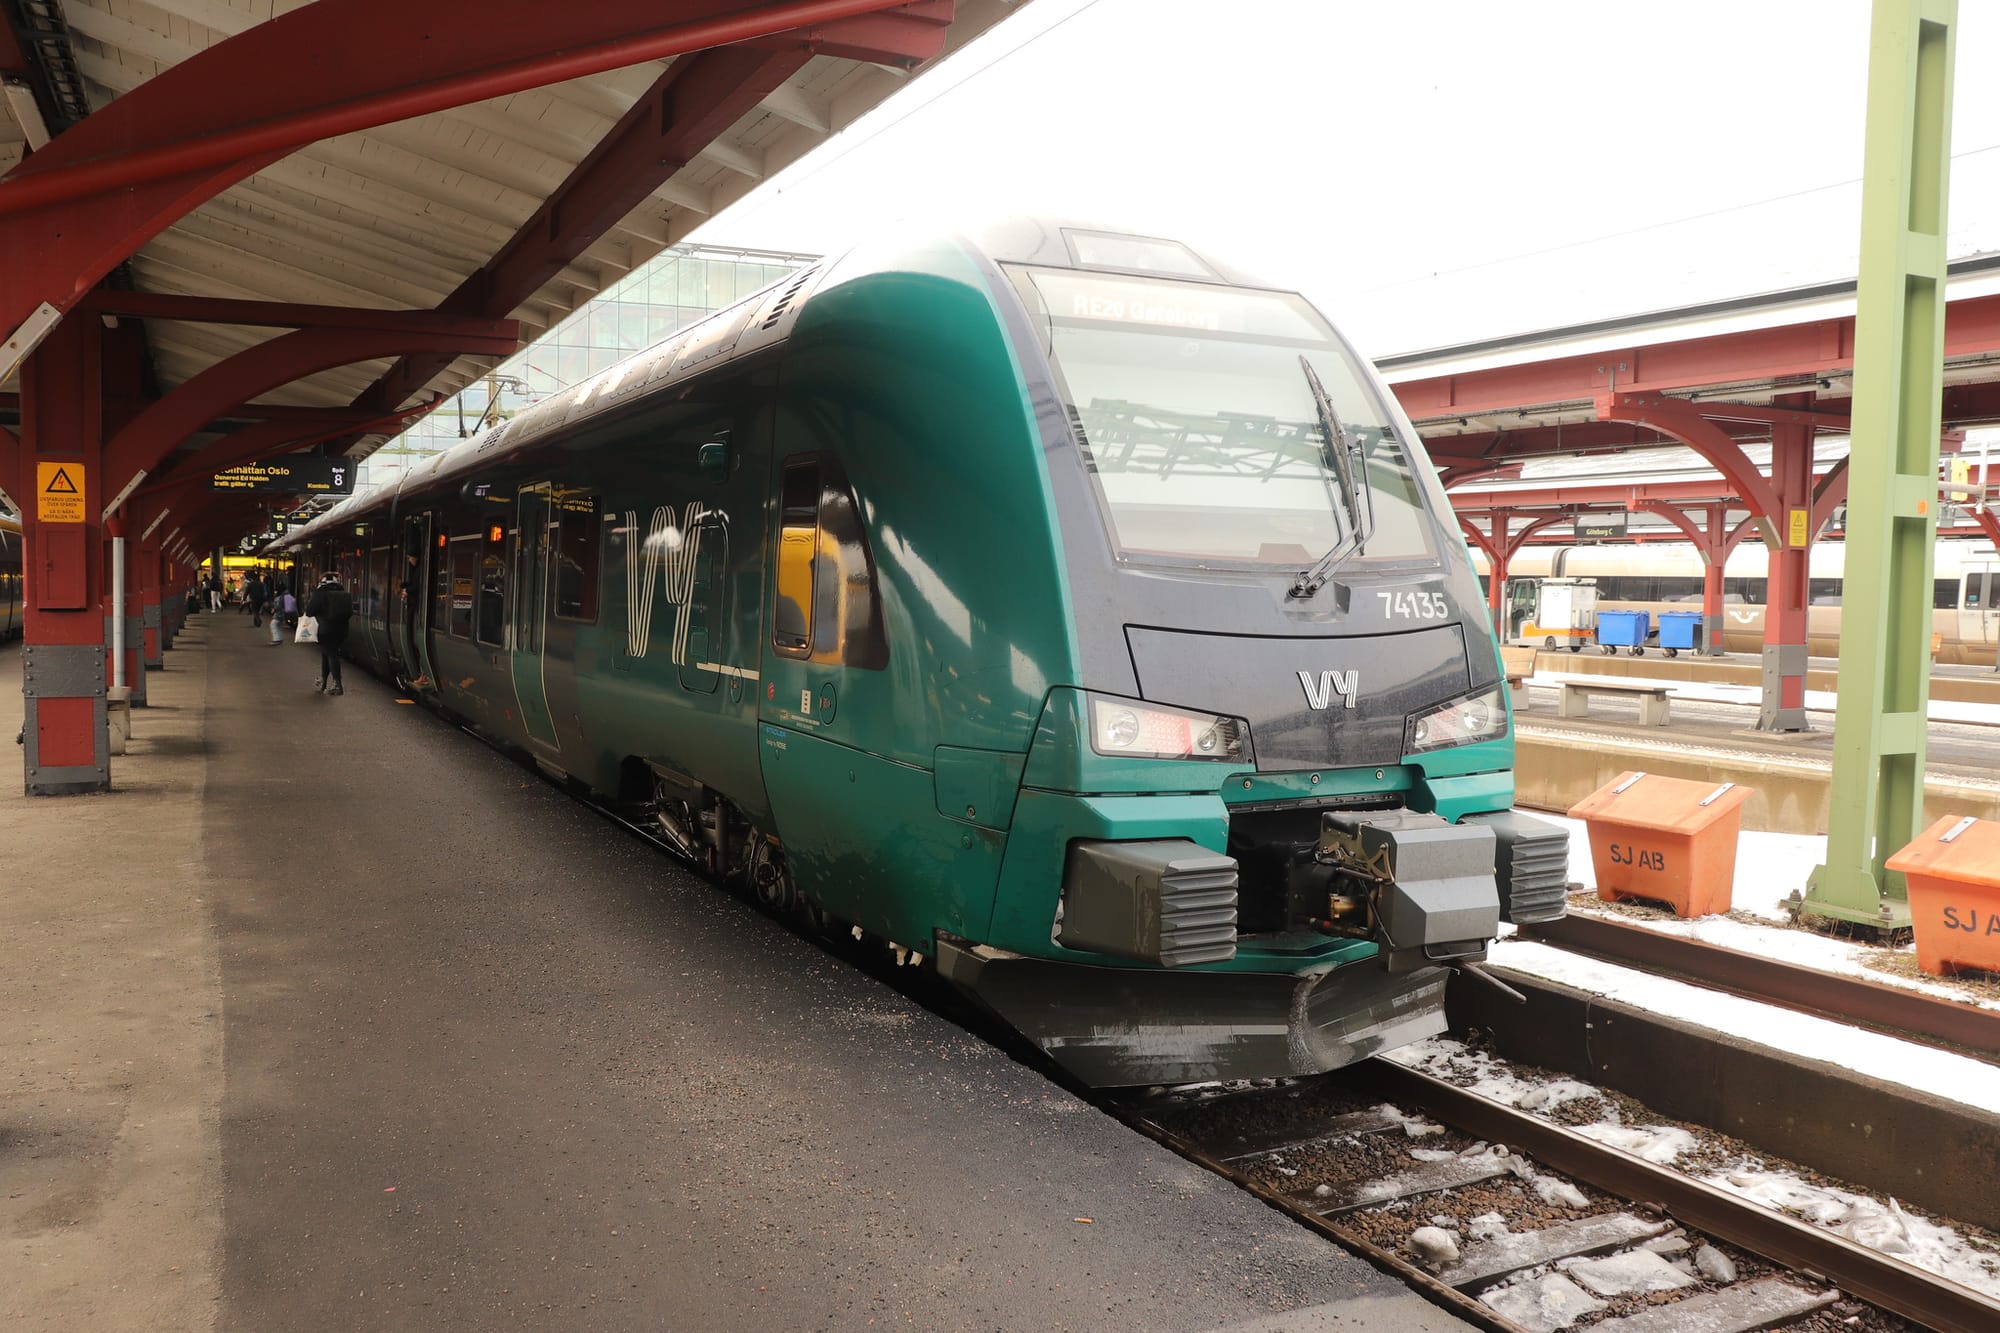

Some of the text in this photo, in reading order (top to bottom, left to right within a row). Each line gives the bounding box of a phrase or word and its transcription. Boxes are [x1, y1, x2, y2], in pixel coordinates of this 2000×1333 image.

[268, 466, 290, 476] Oslo
[334, 474, 343, 486] 8
[1377, 592, 1449, 619] 74135
[1610, 844, 1665, 871] SJ AB
[1943, 906, 1977, 932] SJ
